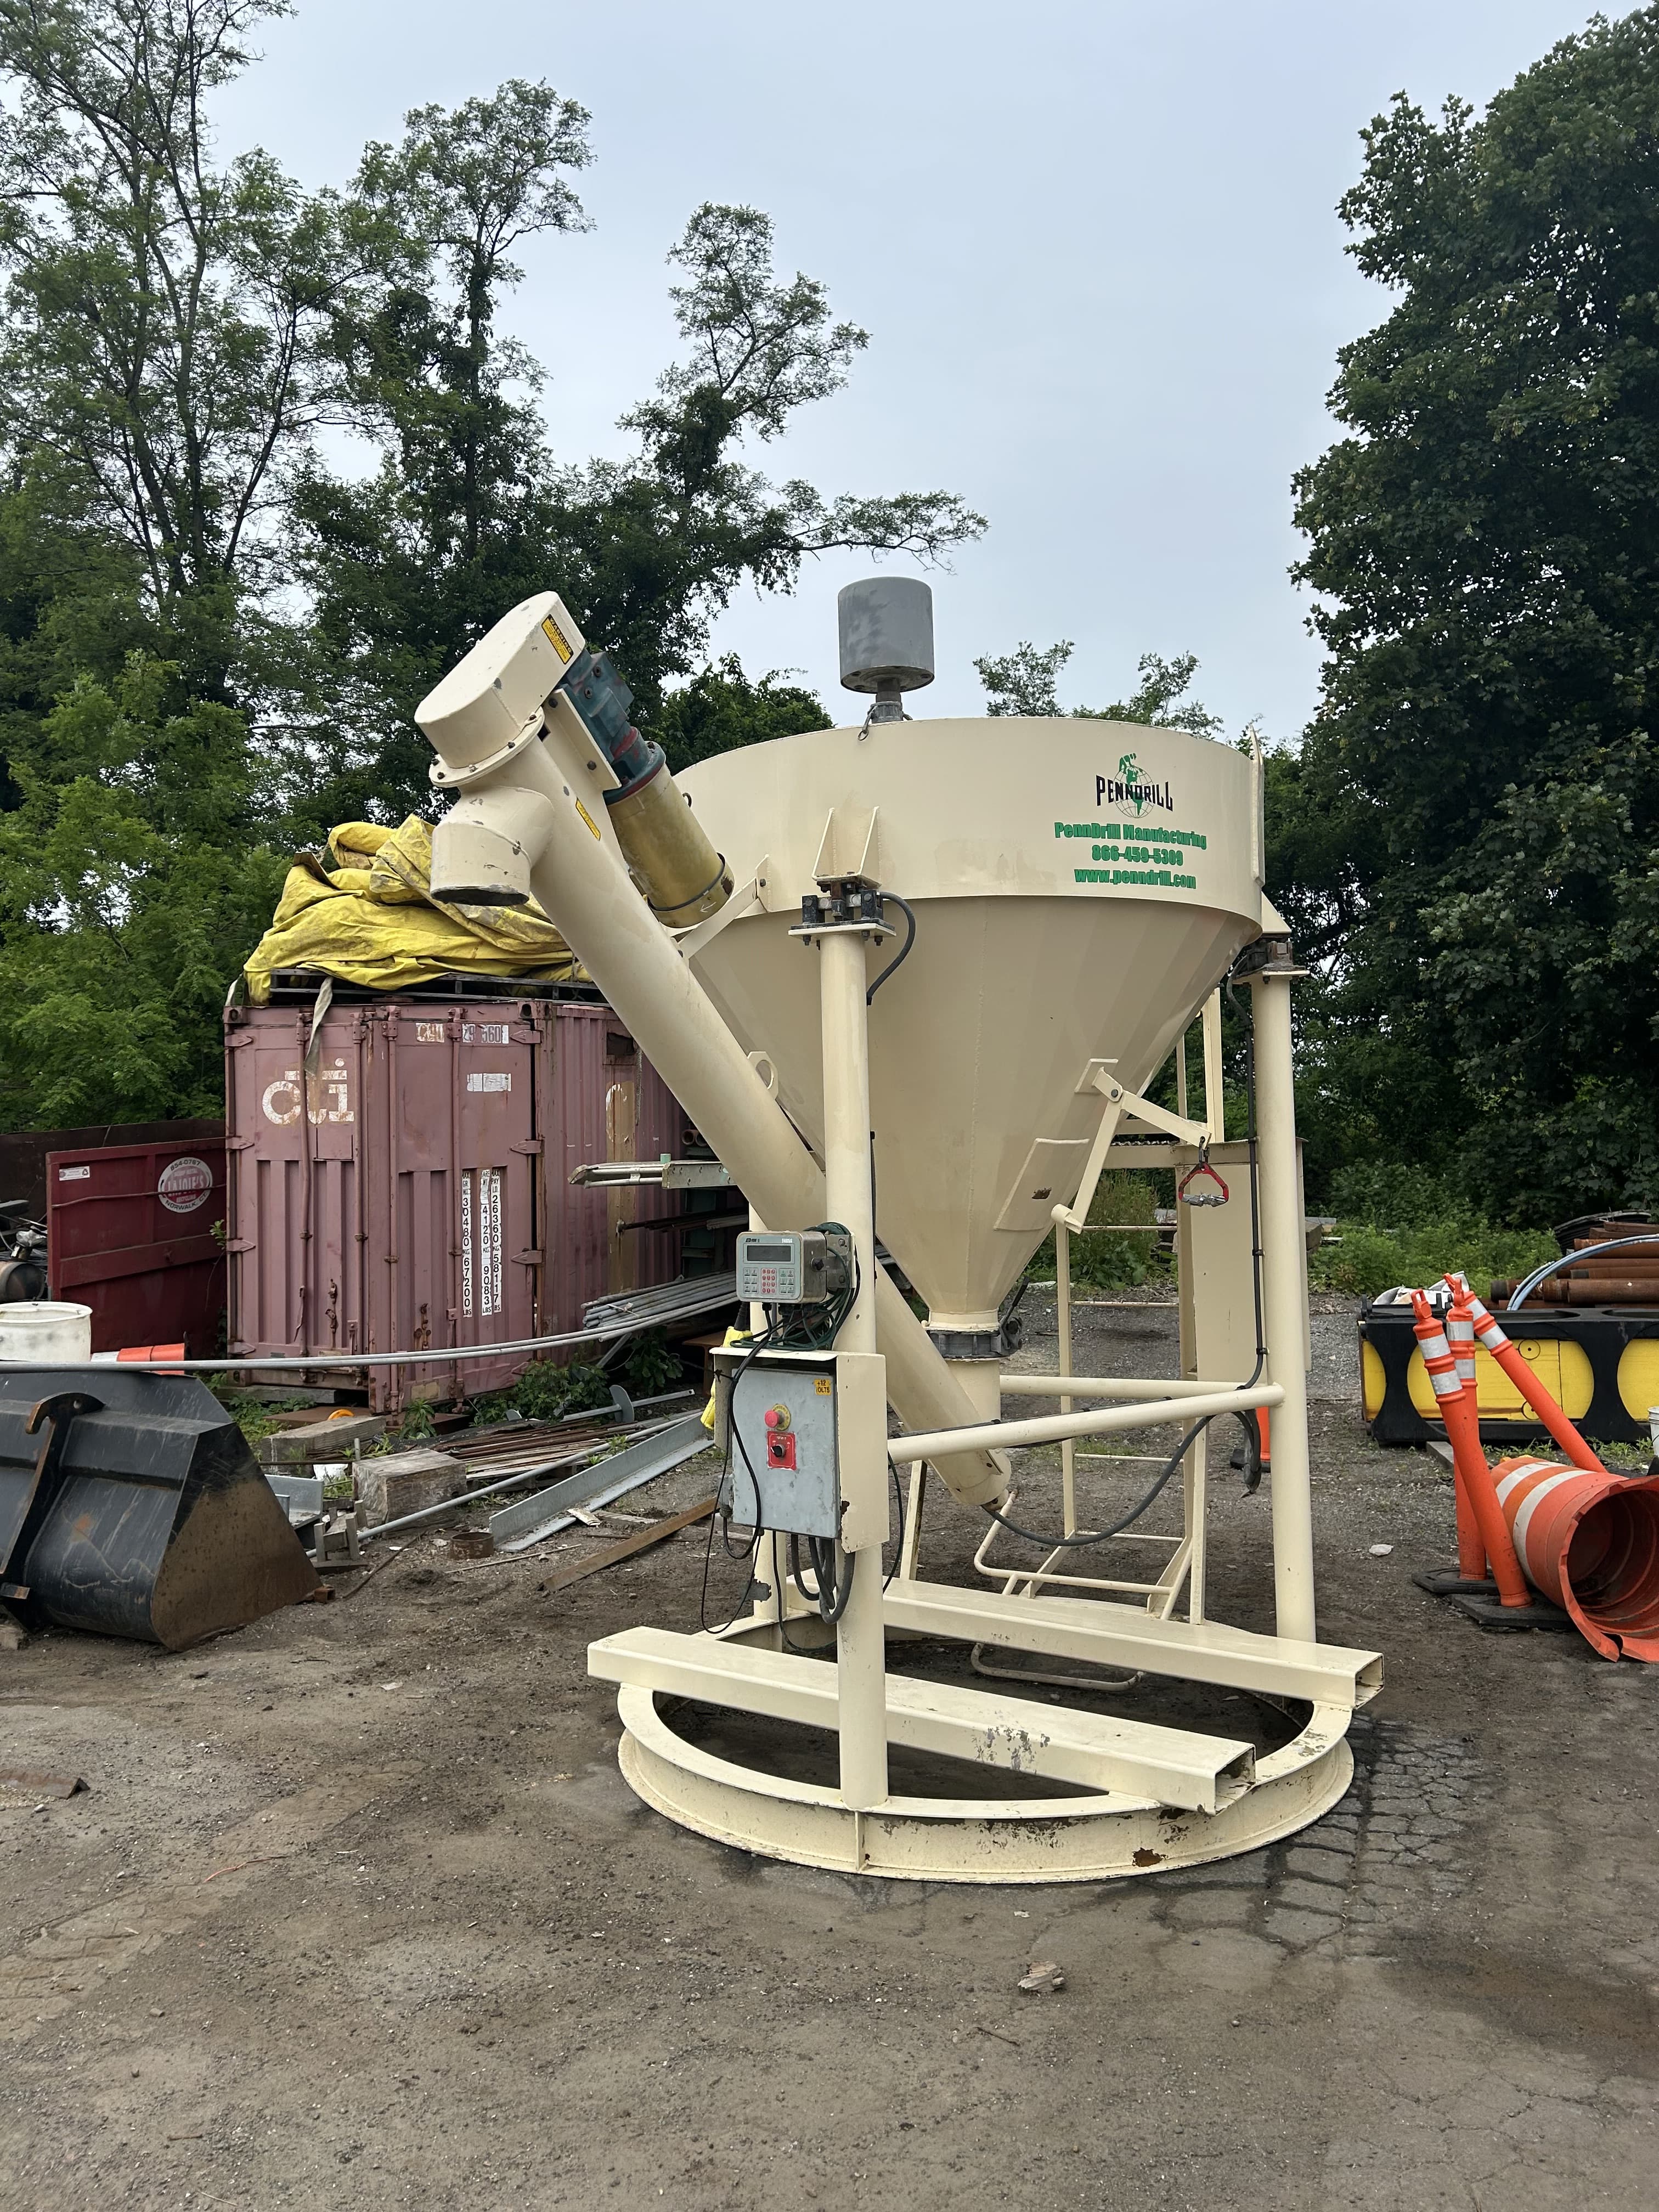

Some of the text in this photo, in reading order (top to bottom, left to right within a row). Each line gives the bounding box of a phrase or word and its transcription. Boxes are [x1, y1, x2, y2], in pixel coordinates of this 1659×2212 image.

[550, 617, 572, 653] WARNING
[1096, 775, 1173, 811] PENNDRILL
[1054, 822, 1207, 850] PennDrill Manufacturing
[1091, 845, 1183, 866] 866-459-5309
[1074, 869, 1197, 889] www.penndrill.com
[170, 1159, 200, 1171] 854-0787
[166, 1200, 197, 1210] NORWALK
